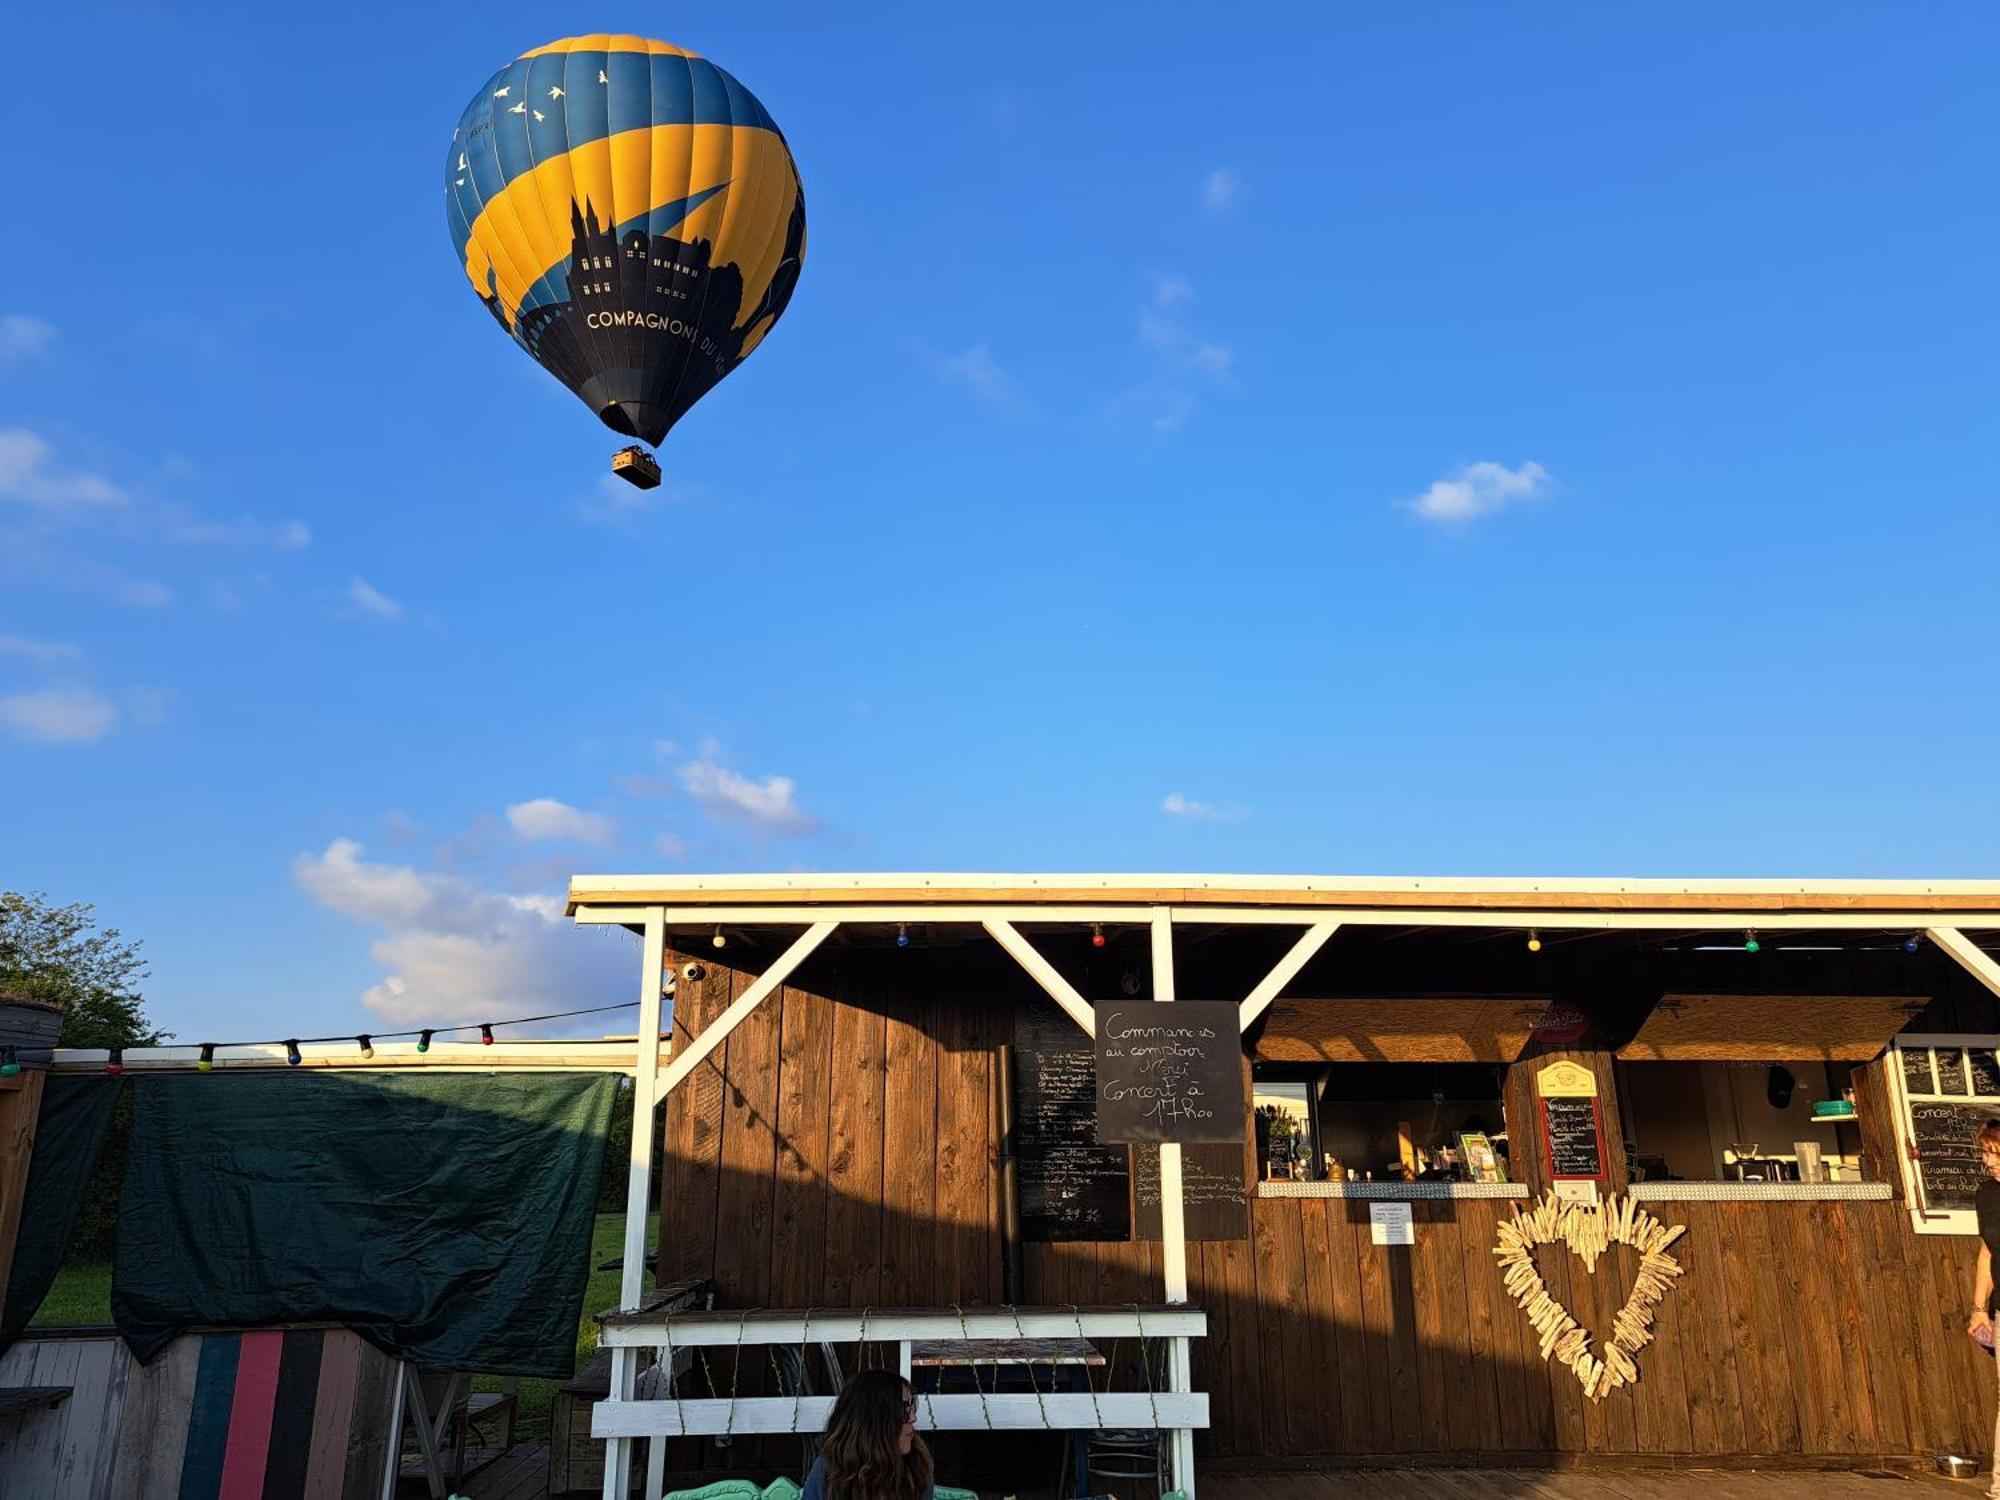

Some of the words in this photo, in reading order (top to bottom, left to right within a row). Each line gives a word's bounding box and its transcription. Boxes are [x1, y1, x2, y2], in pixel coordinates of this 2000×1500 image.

[587, 310, 699, 343] COMPAGNONS
[699, 335, 718, 356] DU
[1106, 1048, 1125, 1057] au
[1139, 1057, 1190, 1077] Merci
[1103, 1077, 1177, 1101] Concert
[1911, 1103, 1963, 1120] Concert
